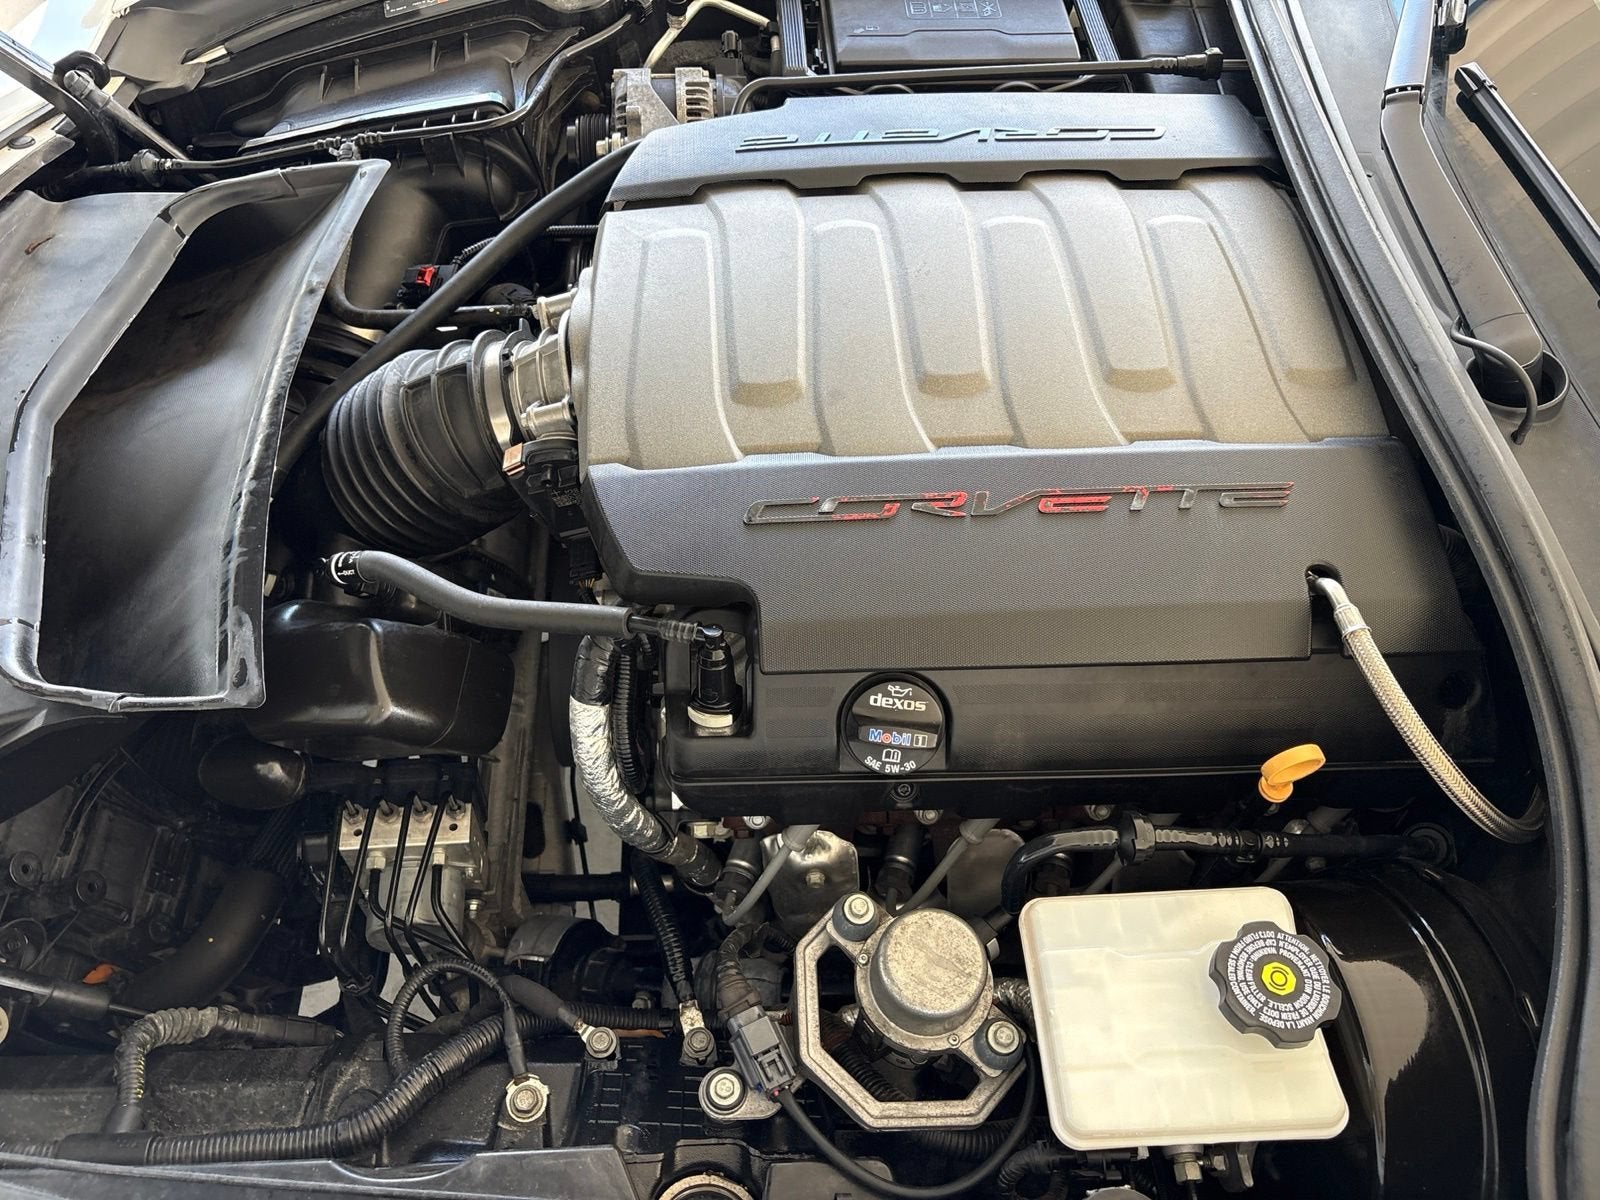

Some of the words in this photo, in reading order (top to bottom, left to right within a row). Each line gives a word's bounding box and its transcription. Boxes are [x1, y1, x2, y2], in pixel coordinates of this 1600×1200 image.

[743, 481, 1295, 525] CORVETTE
[869, 693, 926, 711] dexos
[869, 728, 912, 746] Mobil
[864, 755, 882, 771] SAE
[884, 760, 916, 773] 5W-30
[1243, 932, 1259, 944] FLUID
[1232, 940, 1247, 956] FROM
[1243, 940, 1265, 954] BEFORE
[1228, 959, 1236, 980] SEALED
[1246, 961, 1254, 981] CLEAN
[1240, 982, 1251, 996] USE
[1322, 985, 1331, 994] LE
[1247, 994, 1263, 1009] ONLY
[1299, 1007, 1309, 1018] DE
[1285, 1021, 1296, 1029] LA
